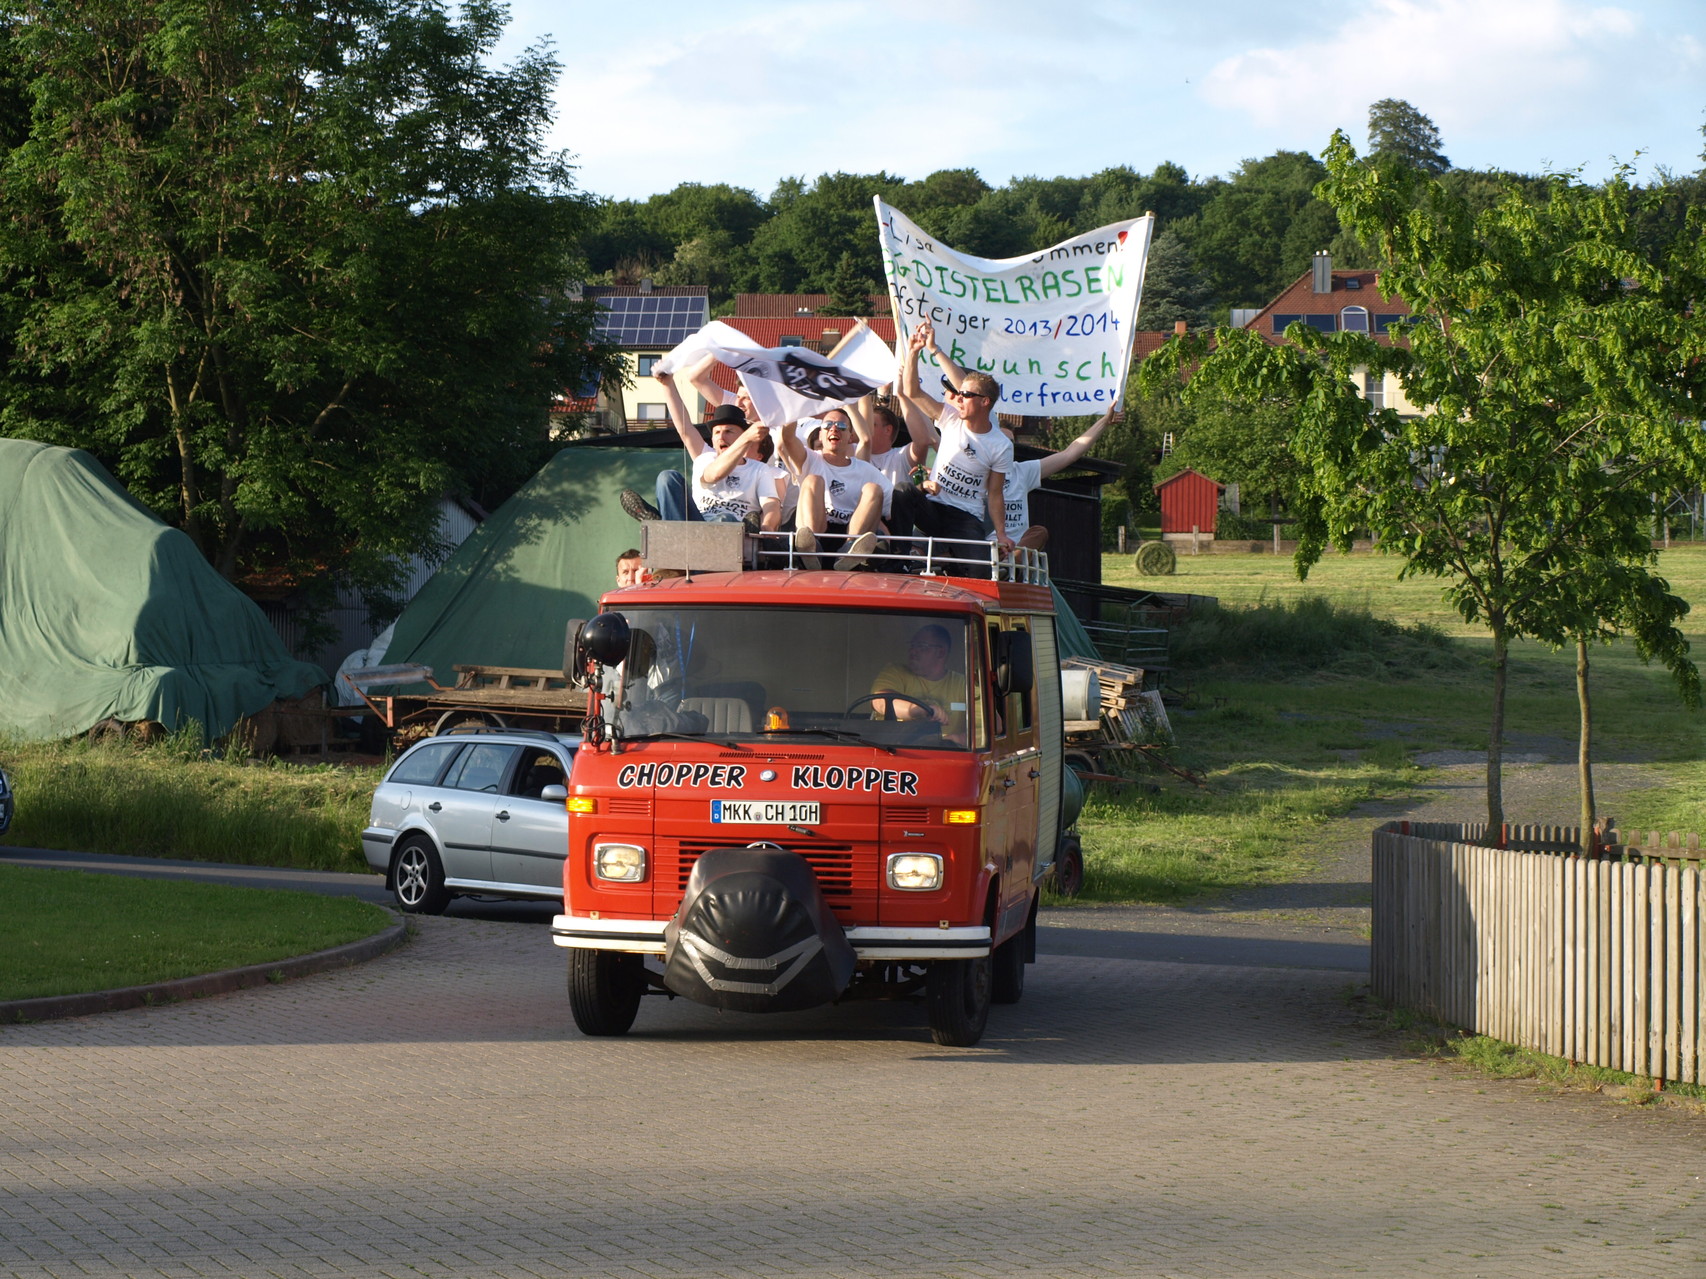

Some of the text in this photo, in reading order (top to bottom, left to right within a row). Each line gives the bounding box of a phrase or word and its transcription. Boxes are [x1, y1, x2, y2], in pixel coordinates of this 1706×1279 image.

[889, 212, 934, 254] Lisa
[1003, 309, 1120, 341] 2013/2014
[942, 465, 982, 487] MISSION
[617, 763, 918, 796] CHOPPER KLOPPER
[722, 804, 752, 821] MKK
[765, 804, 785, 821] CH
[789, 805, 818, 822] 10H
